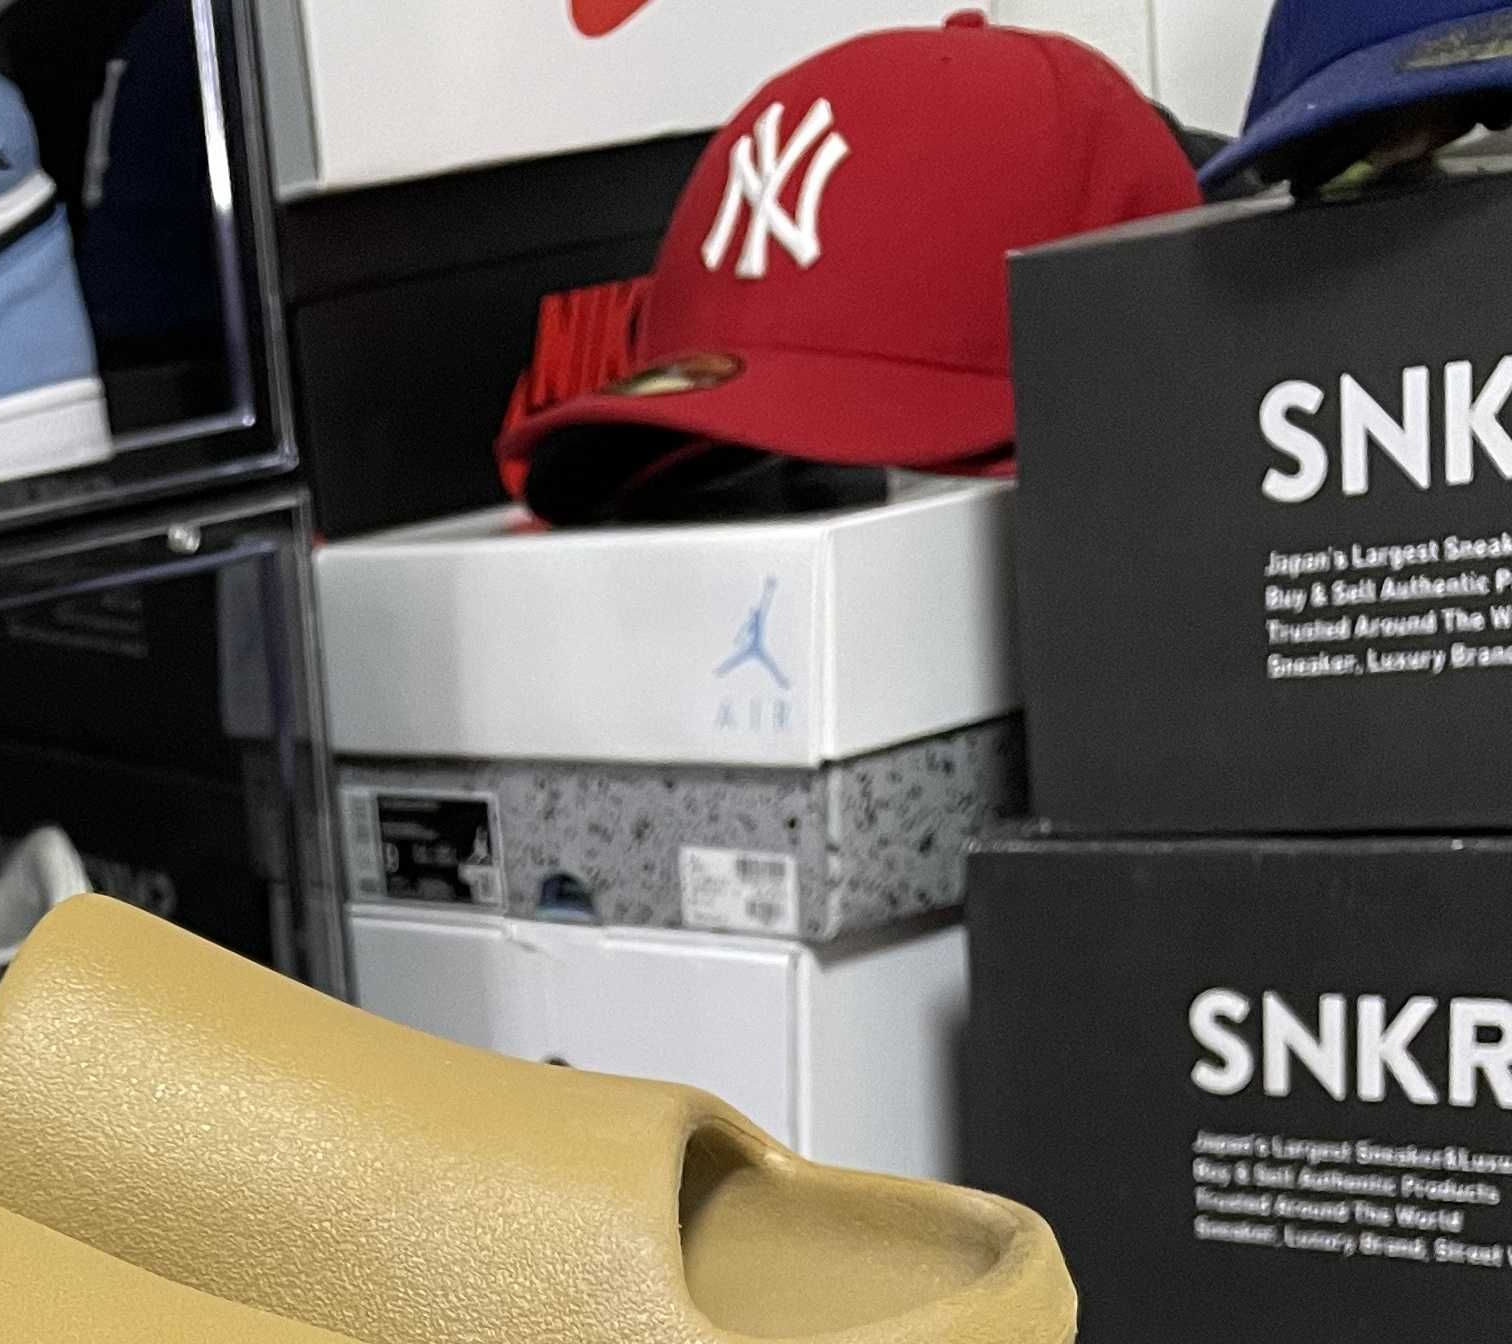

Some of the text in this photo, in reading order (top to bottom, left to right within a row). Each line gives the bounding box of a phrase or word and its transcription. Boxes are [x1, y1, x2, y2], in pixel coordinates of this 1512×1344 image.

[1259, 354, 1512, 502] SNK
[1265, 545, 1349, 579] Japan's
[1352, 540, 1439, 571] Largest
[1265, 584, 1308, 614] Buy
[1331, 578, 1377, 606] Sell
[1380, 570, 1491, 601] Authentic
[1265, 615, 1353, 645] Trusted
[1354, 611, 1438, 640] Around
[1440, 606, 1486, 633] The
[1366, 648, 1447, 675] Luxury
[1188, 986, 1512, 1110] SNKR
